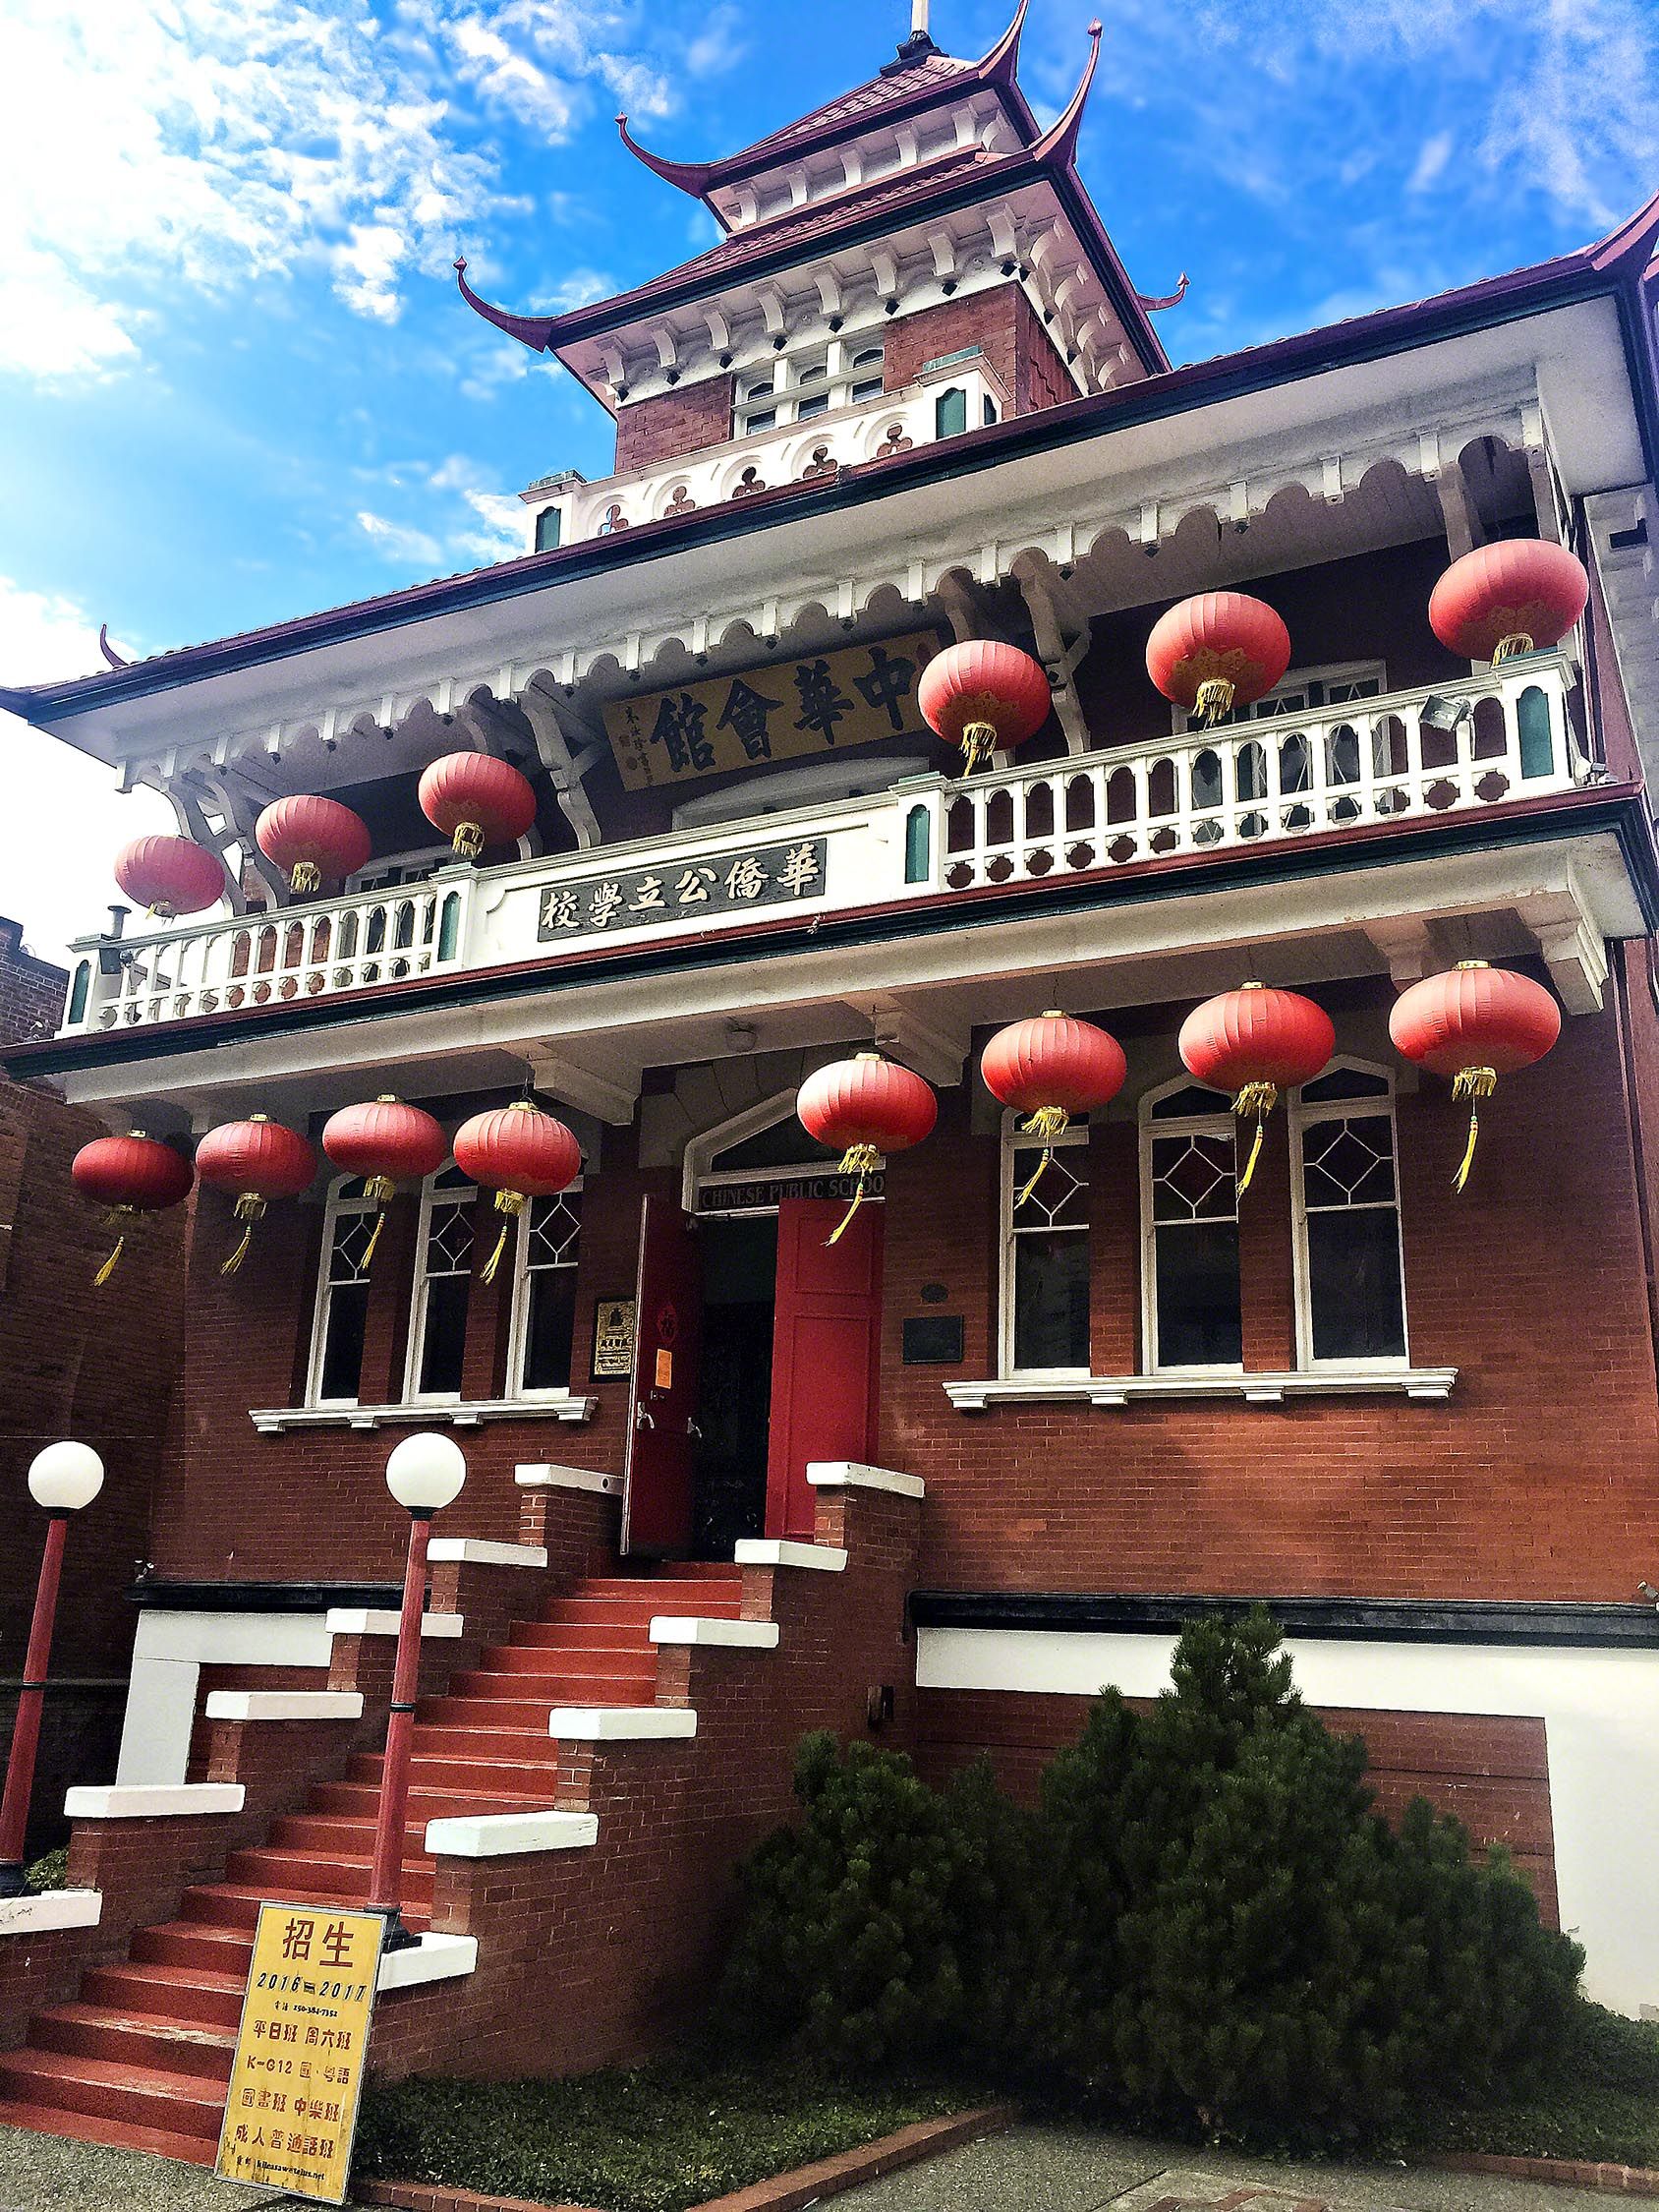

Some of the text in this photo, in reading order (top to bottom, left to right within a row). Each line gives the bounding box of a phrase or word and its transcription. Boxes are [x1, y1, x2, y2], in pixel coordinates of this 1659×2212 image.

[650, 645, 916, 774] 中華會館
[542, 843, 820, 929] 華僑公立學校
[702, 1186, 765, 1208] CHINESE
[770, 1180, 824, 1202] PUBLIC
[283, 1918, 354, 1967] 招生
[254, 2020, 352, 2050] 平日班 周六班
[247, 2055, 293, 2074] K-G12
